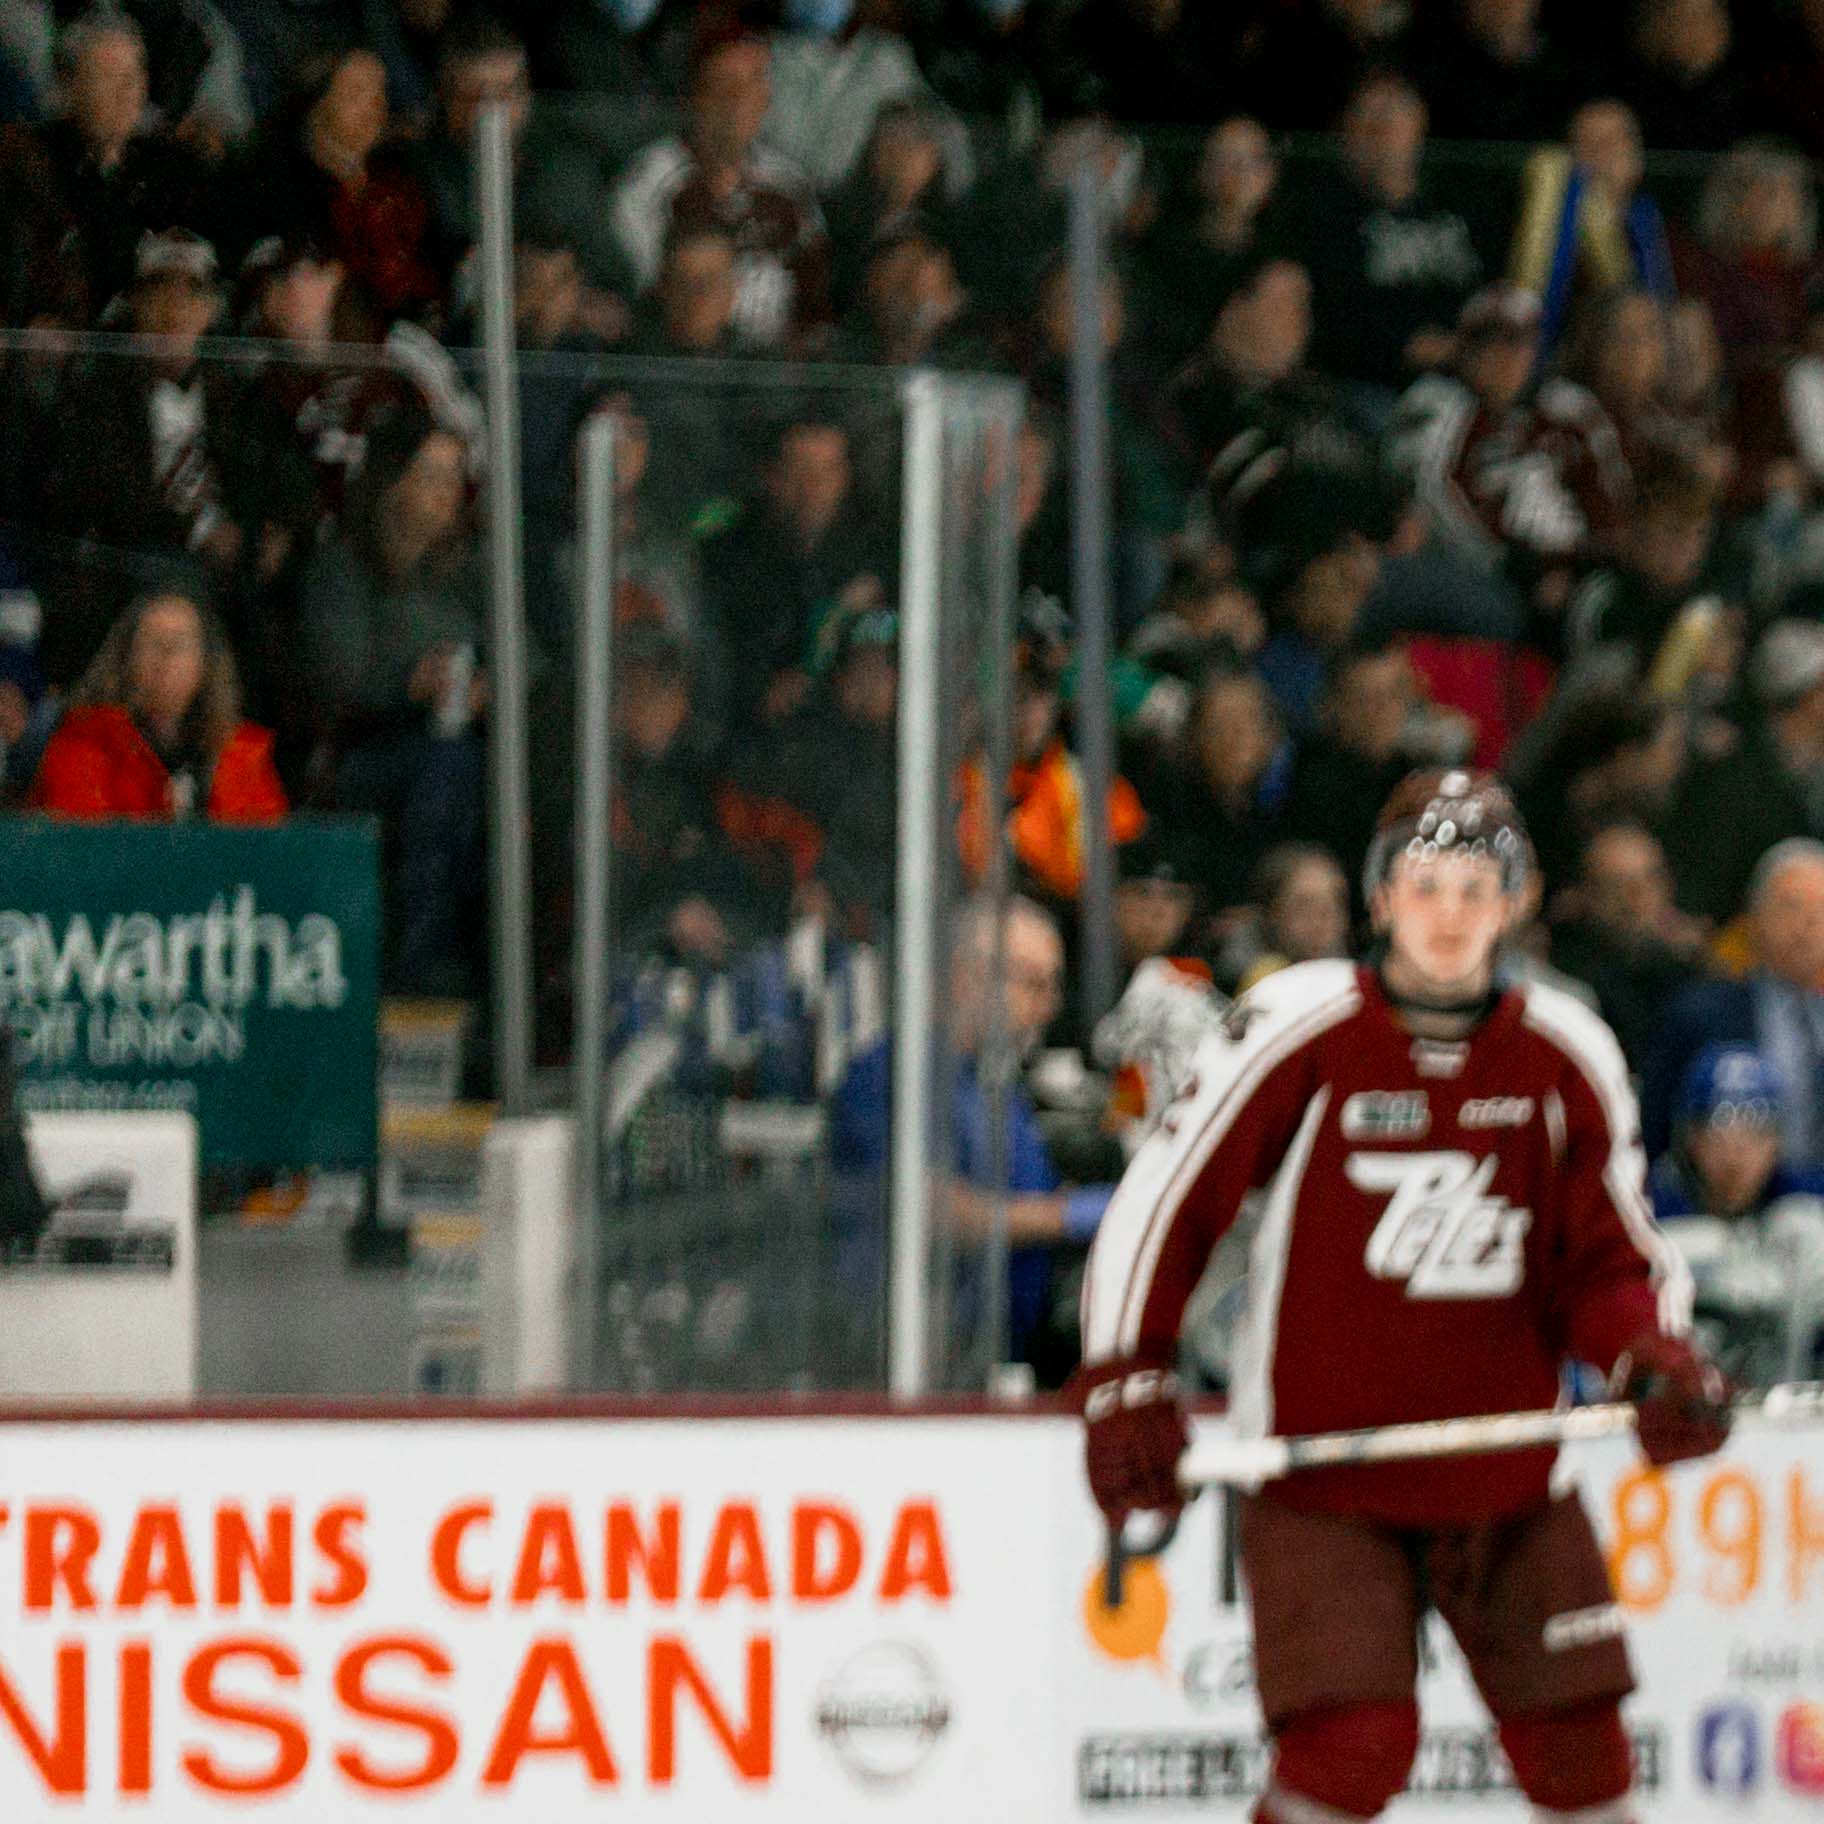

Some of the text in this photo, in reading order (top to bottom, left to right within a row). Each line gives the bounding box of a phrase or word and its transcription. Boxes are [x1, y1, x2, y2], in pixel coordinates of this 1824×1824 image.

[0, 1497, 952, 1607] RANS CANADA
[0, 1632, 776, 1797] NISSAN
